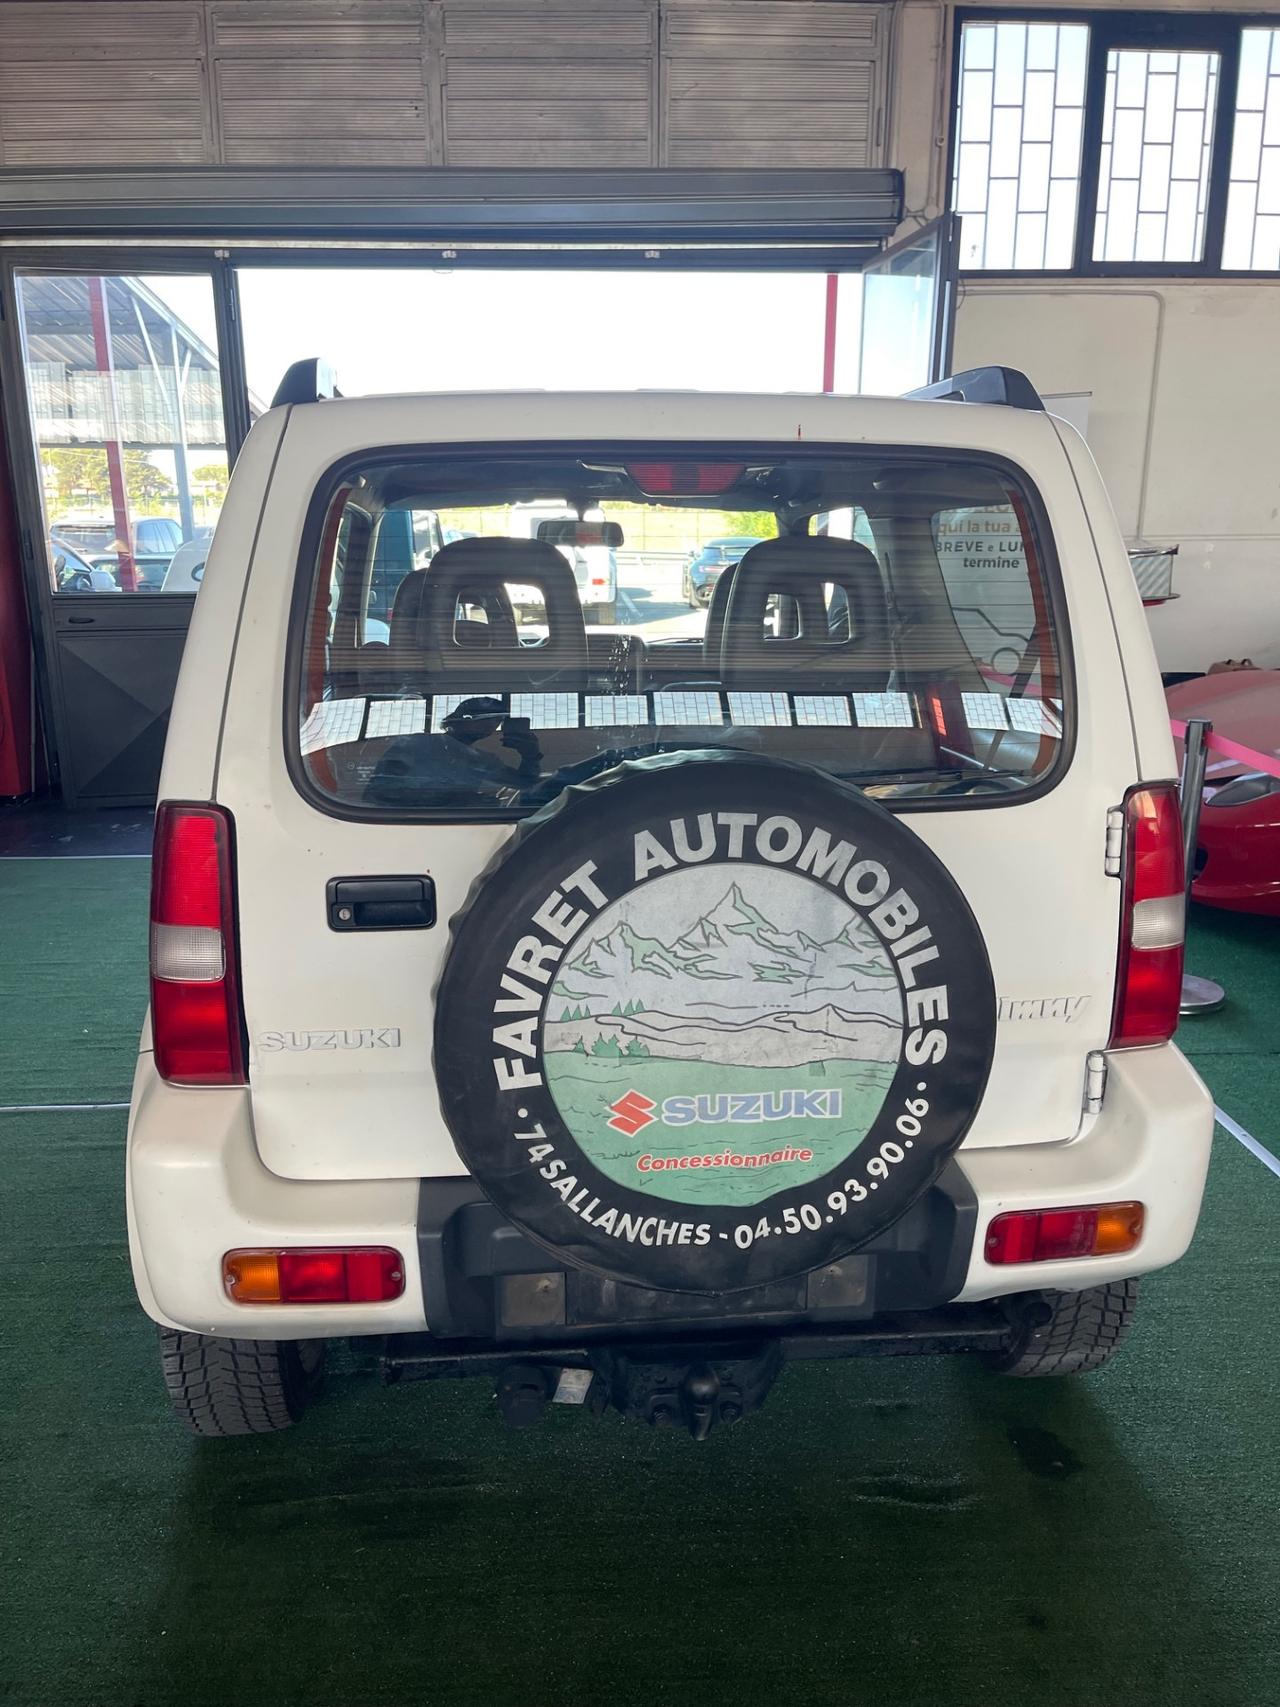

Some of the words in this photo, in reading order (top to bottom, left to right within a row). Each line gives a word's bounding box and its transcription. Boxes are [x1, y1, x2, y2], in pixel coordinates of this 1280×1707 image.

[968, 520, 980, 533] la
[984, 521, 1010, 533] tua
[936, 541, 984, 552] BREVE
[963, 556, 1020, 568] termine
[493, 860, 609, 1091] FAVRET
[634, 812, 948, 1066] AUTOMOBILES
[258, 1028, 401, 1051] SUZUKI
[661, 1089, 842, 1127] SUZUKI
[637, 1145, 814, 1172] Concessionnaire
[734, 1098, 930, 1249] 04.50.93.90.06
